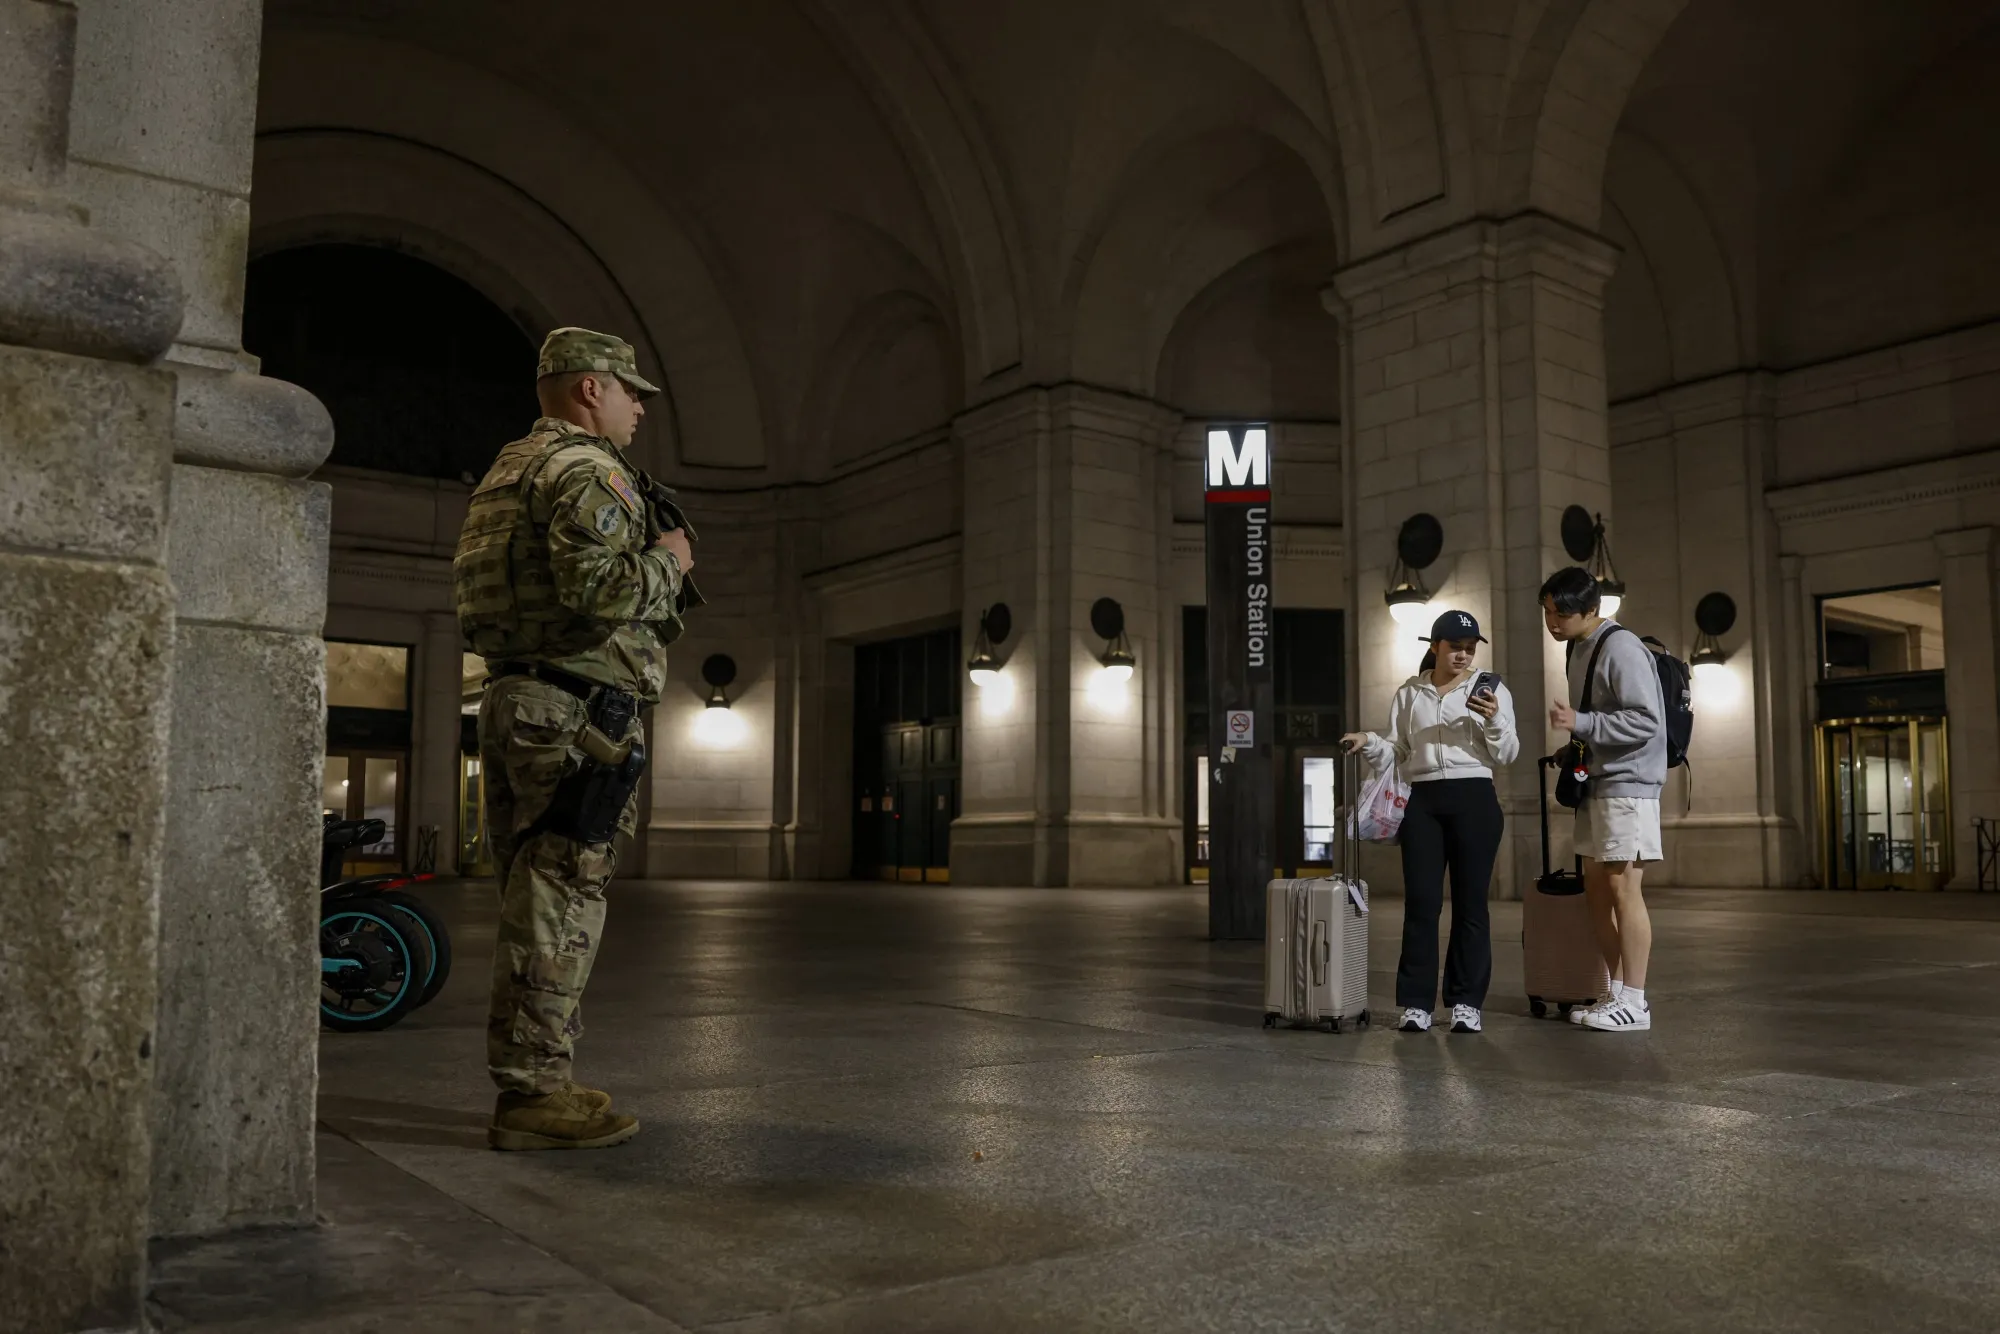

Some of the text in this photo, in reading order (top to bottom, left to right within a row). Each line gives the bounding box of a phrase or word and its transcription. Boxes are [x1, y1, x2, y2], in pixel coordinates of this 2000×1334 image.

[1208, 429, 1267, 486] M
[1246, 507, 1269, 667] Union Station
[1458, 614, 1473, 628] LA
